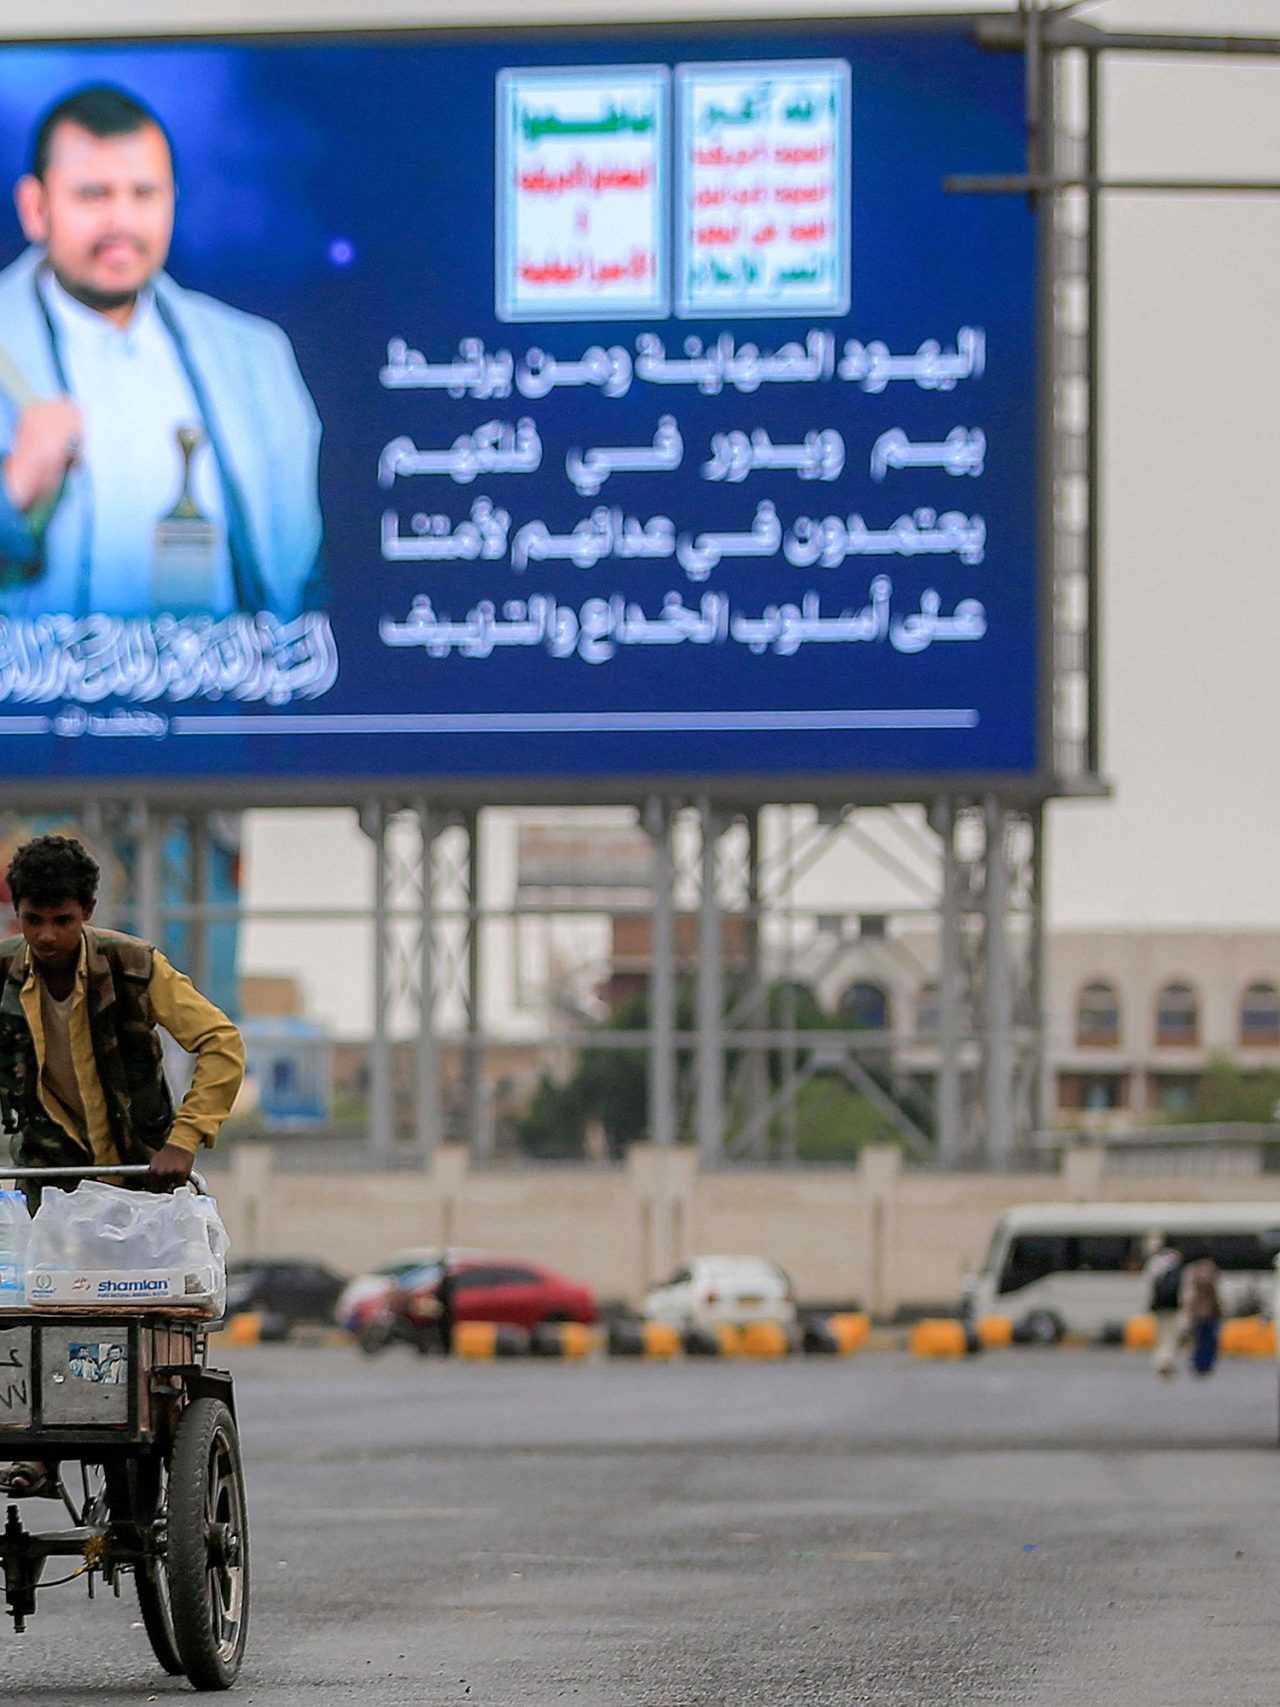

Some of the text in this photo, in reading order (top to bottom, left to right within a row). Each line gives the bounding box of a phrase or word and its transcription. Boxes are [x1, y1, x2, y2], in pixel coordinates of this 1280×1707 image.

[379, 327, 986, 399] اليهود الصهاينة ومن يرتبط
[378, 415, 986, 496] بهم ويدور في فلكهم
[381, 496, 986, 581] يعتمدون في عدائهم لأمتنا
[378, 574, 987, 663] على أسلوب الخداع والتزييف
[97, 1280, 168, 1292] shamlan
